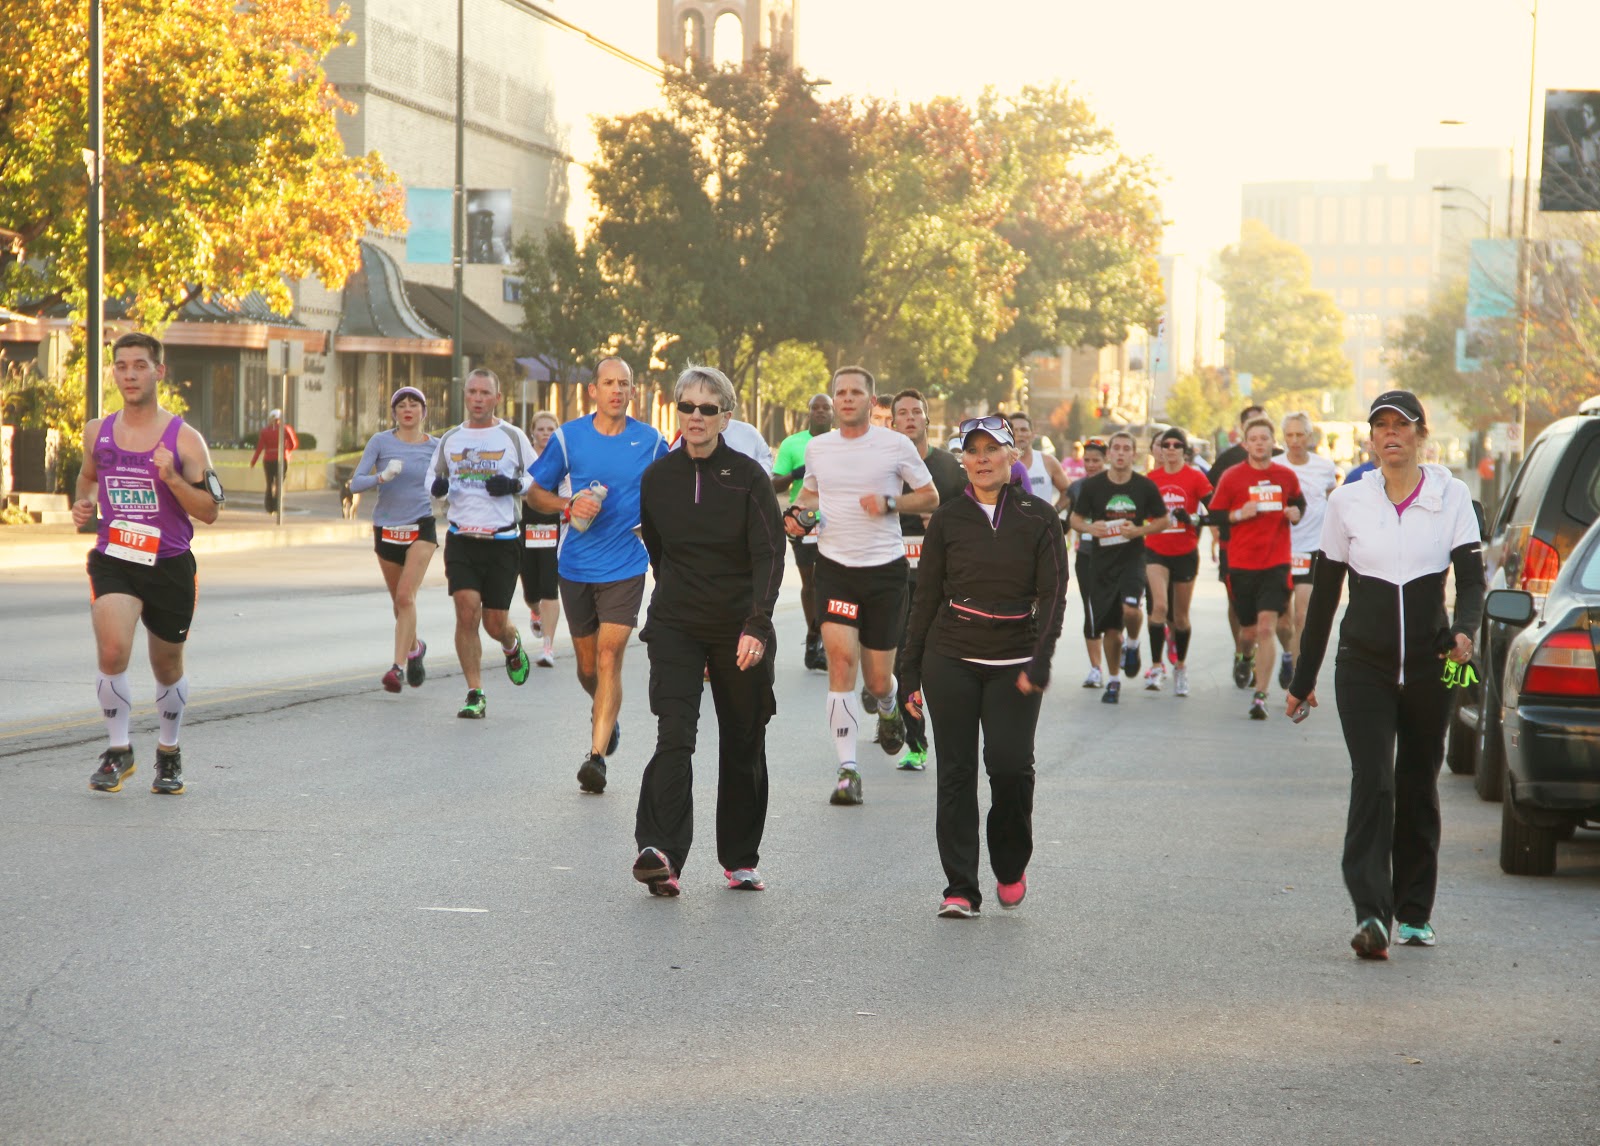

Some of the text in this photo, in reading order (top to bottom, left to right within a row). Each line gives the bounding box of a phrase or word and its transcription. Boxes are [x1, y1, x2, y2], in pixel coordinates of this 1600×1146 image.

[116, 466, 149, 475] MID-AMERICA
[108, 489, 156, 504] TEAM
[830, 600, 856, 616] 1753
